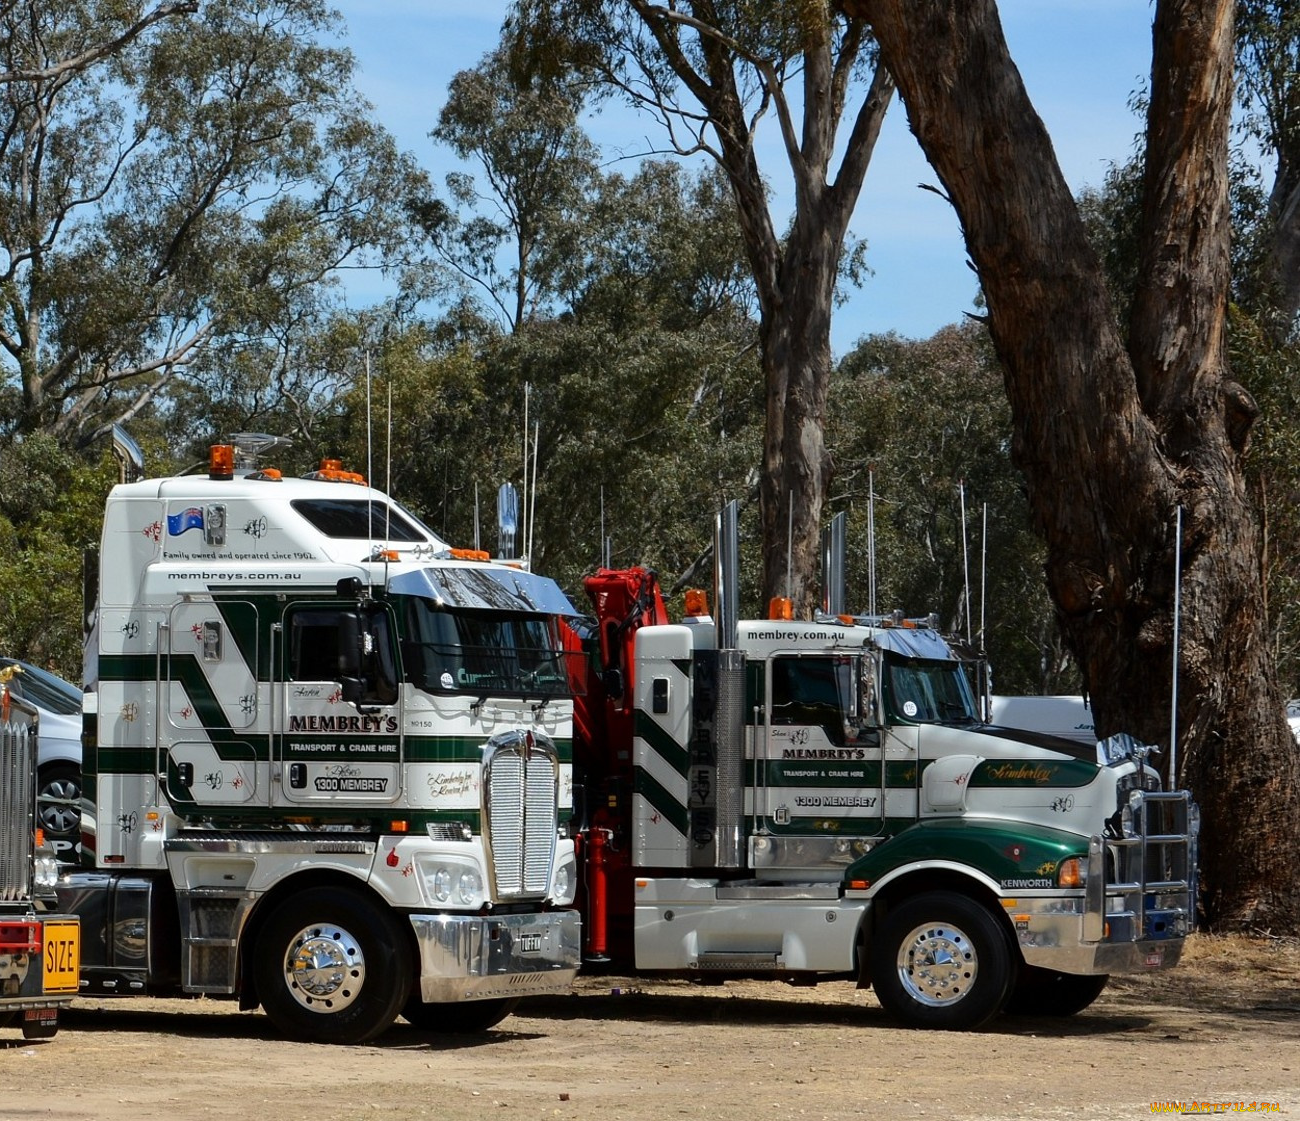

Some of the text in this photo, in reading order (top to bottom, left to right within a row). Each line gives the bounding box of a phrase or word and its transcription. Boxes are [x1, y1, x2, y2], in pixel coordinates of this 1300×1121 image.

[163, 551, 190, 560] Family
[191, 551, 216, 560] owned
[218, 552, 233, 560] and
[235, 551, 270, 561] operated
[272, 552, 292, 560] since
[168, 571, 302, 581] membreys.com.au
[748, 630, 845, 642] membrey.com.au
[289, 714, 398, 732] MEMBREY'S
[290, 744, 336, 752] TRANSPORT
[339, 744, 346, 752] &
[349, 744, 376, 752] CRANE
[782, 749, 865, 759] MEMBREY'S
[315, 778, 388, 791] 1300 MEMBREY
[795, 796, 876, 807] 1300 MEMBREY
[1000, 878, 1052, 889] KENWORTH
[46, 940, 75, 974] SIZE
